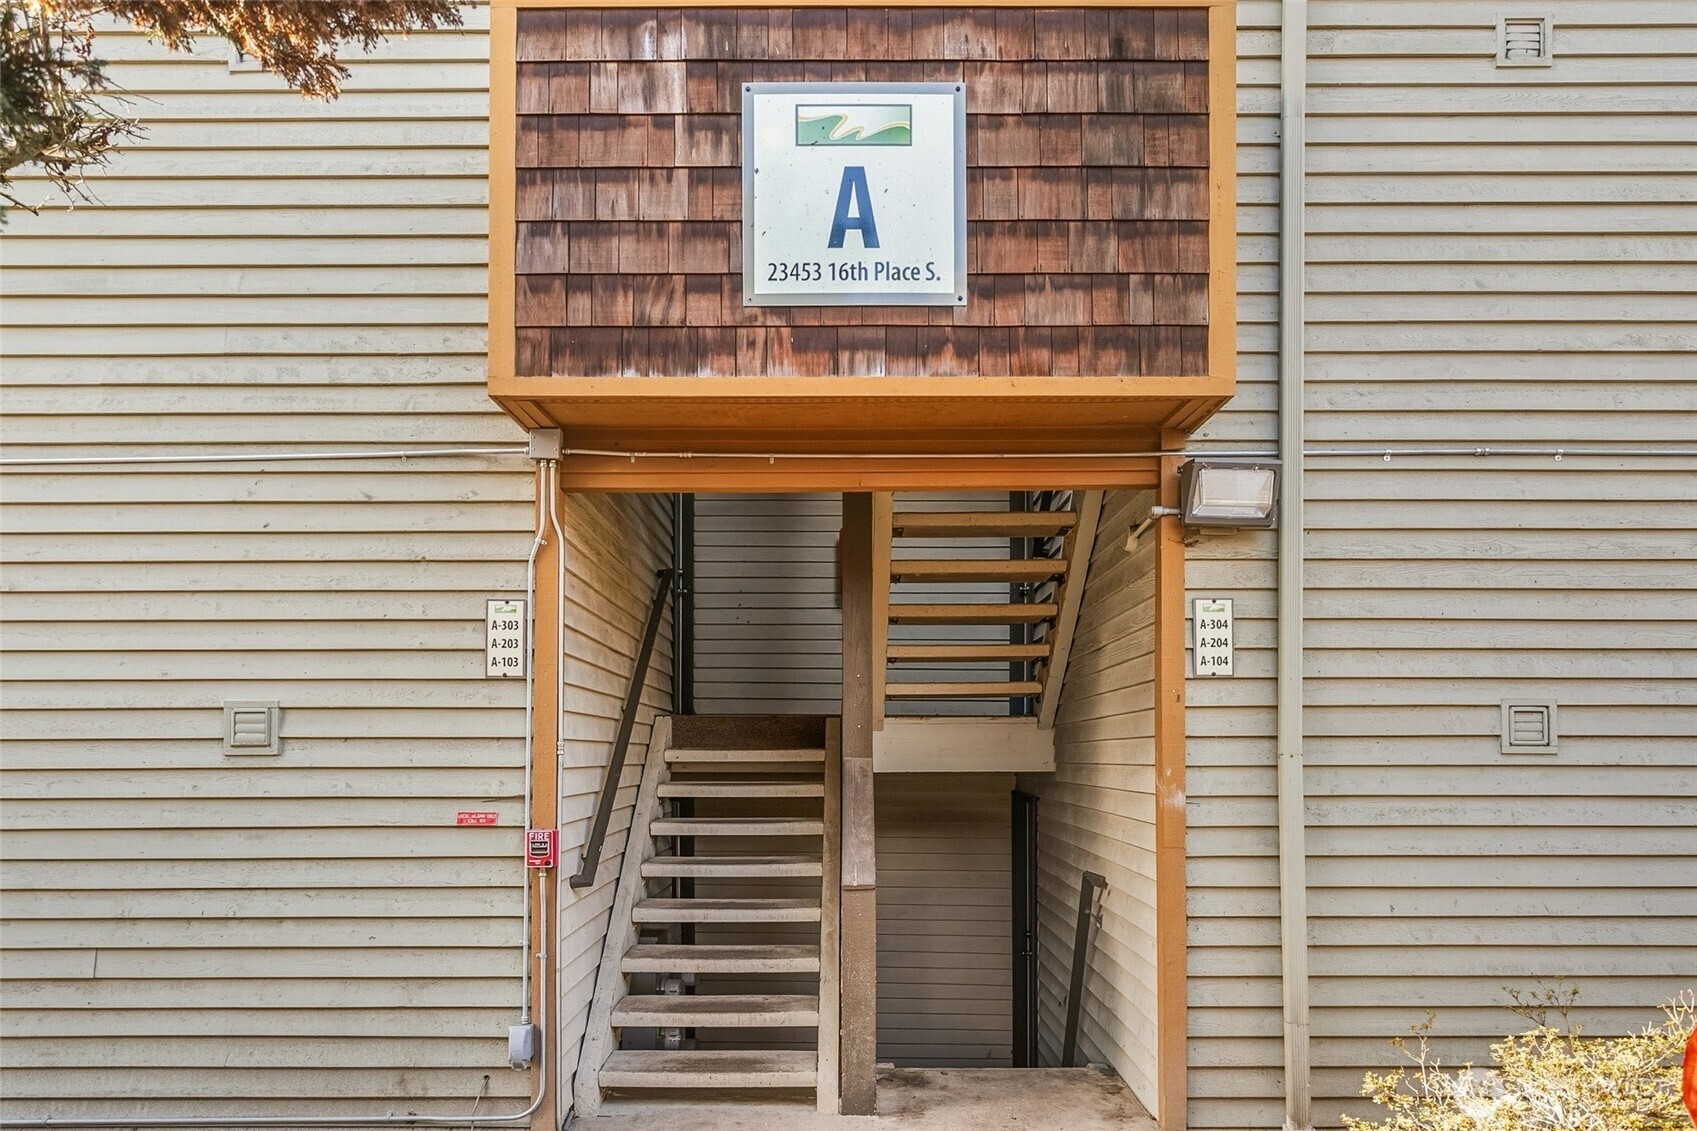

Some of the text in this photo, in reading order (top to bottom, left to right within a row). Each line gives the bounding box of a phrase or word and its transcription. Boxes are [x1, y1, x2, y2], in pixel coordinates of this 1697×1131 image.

[827, 166, 881, 249] A
[767, 261, 941, 281] 23453 16th Place S.
[491, 620, 519, 631] A-303
[1200, 619, 1229, 630] A-304
[491, 638, 519, 649] A-203
[1200, 637, 1229, 648] A-204
[491, 656, 519, 668] A-103
[1200, 655, 1229, 667] A-104
[529, 832, 550, 841] FIRE
